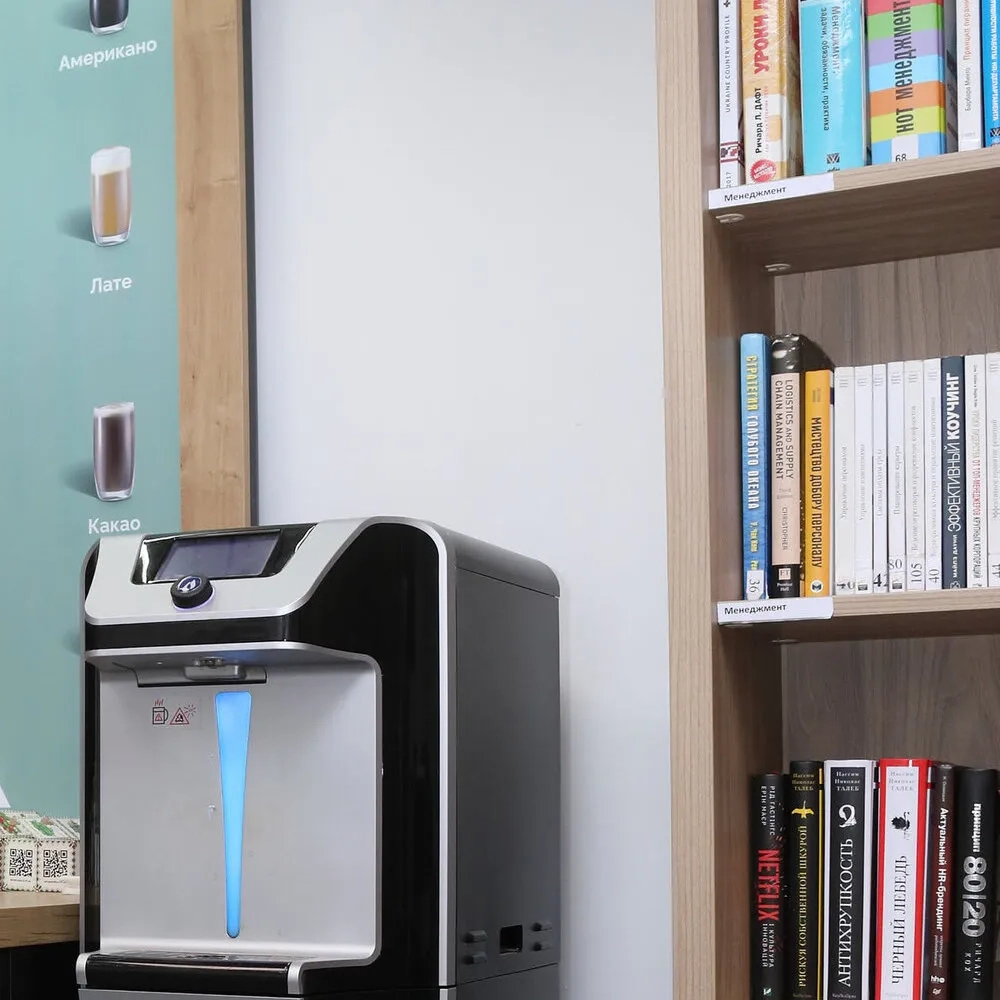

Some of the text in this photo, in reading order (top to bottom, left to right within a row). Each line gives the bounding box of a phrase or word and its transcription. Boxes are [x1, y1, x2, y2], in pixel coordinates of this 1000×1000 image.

[754, 16, 770, 74] УРОКИ
[820, 7, 828, 38] задачи,
[59, 39, 157, 72] Американо
[820, 40, 829, 94] обязанности,
[754, 87, 762, 110] ДАФТ
[755, 123, 763, 154] Ричард
[724, 185, 787, 202] Менеджмент
[90, 276, 132, 294] Лате
[775, 380, 784, 480] CHAIN MANAGEMENT
[785, 380, 794, 480] LOGISTICS AND SUPPLY
[947, 373, 960, 440] КОУЧИНГ
[746, 355, 760, 510] СТРАТЕГИЯ ГОЛУБОГО ОКЕАНА
[944, 441, 961, 532] ЭФФЕКТИВНЫЙ
[88, 517, 141, 535] Какао
[749, 579, 760, 593] 36
[911, 562, 922, 583] 105
[928, 568, 940, 584] 40
[724, 604, 787, 615] Менеджмент
[798, 825, 808, 869] ШКУРОЙ
[937, 807, 949, 865] Актуальный
[972, 803, 982, 853] принцип
[758, 849, 781, 921] NETFLIX
[798, 871, 808, 948] СОБСТВЕННОЙ
[895, 855, 909, 914] ЛЕБЕДЬ
[936, 868, 948, 932] HR-брендинг
[838, 838, 853, 987] АНТИХРУПКОСТЬ
[798, 949, 807, 987] РИСКУЯ
[890, 919, 905, 985] ЧЕРНЫЙ
[973, 943, 981, 984] РИЧАРД
